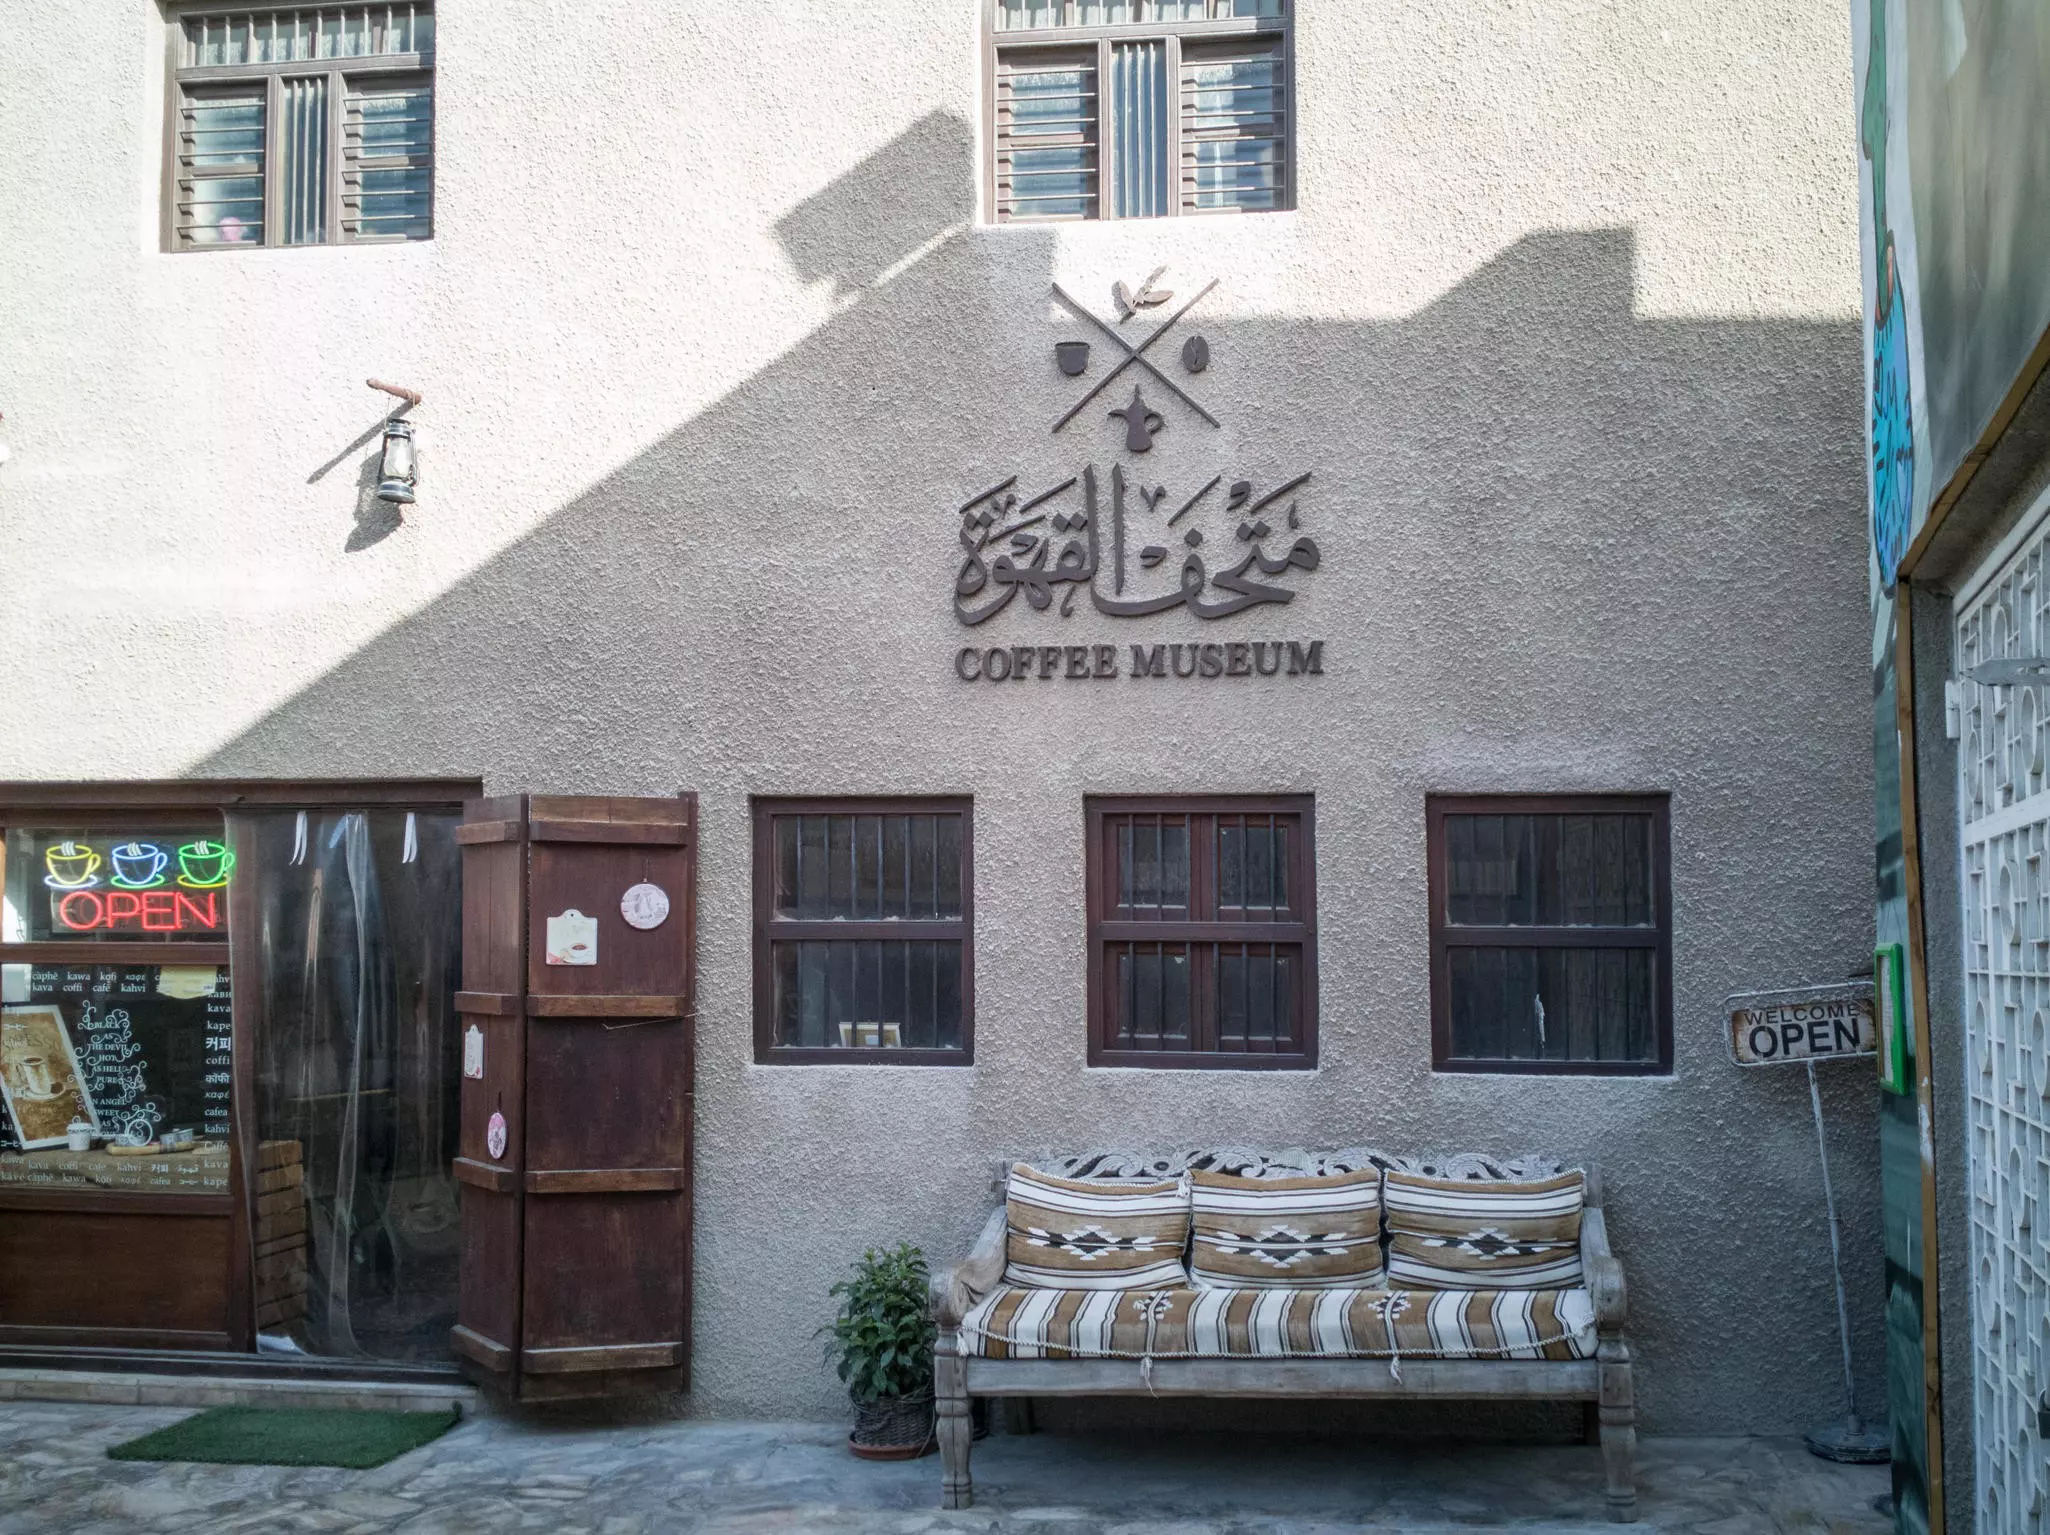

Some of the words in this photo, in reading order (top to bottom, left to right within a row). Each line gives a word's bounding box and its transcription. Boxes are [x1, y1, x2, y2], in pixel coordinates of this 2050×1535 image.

[955, 644, 1118, 681] COFFEE
[1130, 641, 1324, 679] MUSEUM
[59, 891, 216, 930] OPEN
[67, 972, 91, 981] kawa
[32, 982, 53, 992] kava
[121, 983, 146, 993] kahvi
[207, 1003, 231, 1013] kava
[1744, 1004, 1860, 1026] WELCOME
[207, 1020, 231, 1032] kape
[205, 1036, 232, 1052] 커피
[1750, 1018, 1861, 1058] OPEN
